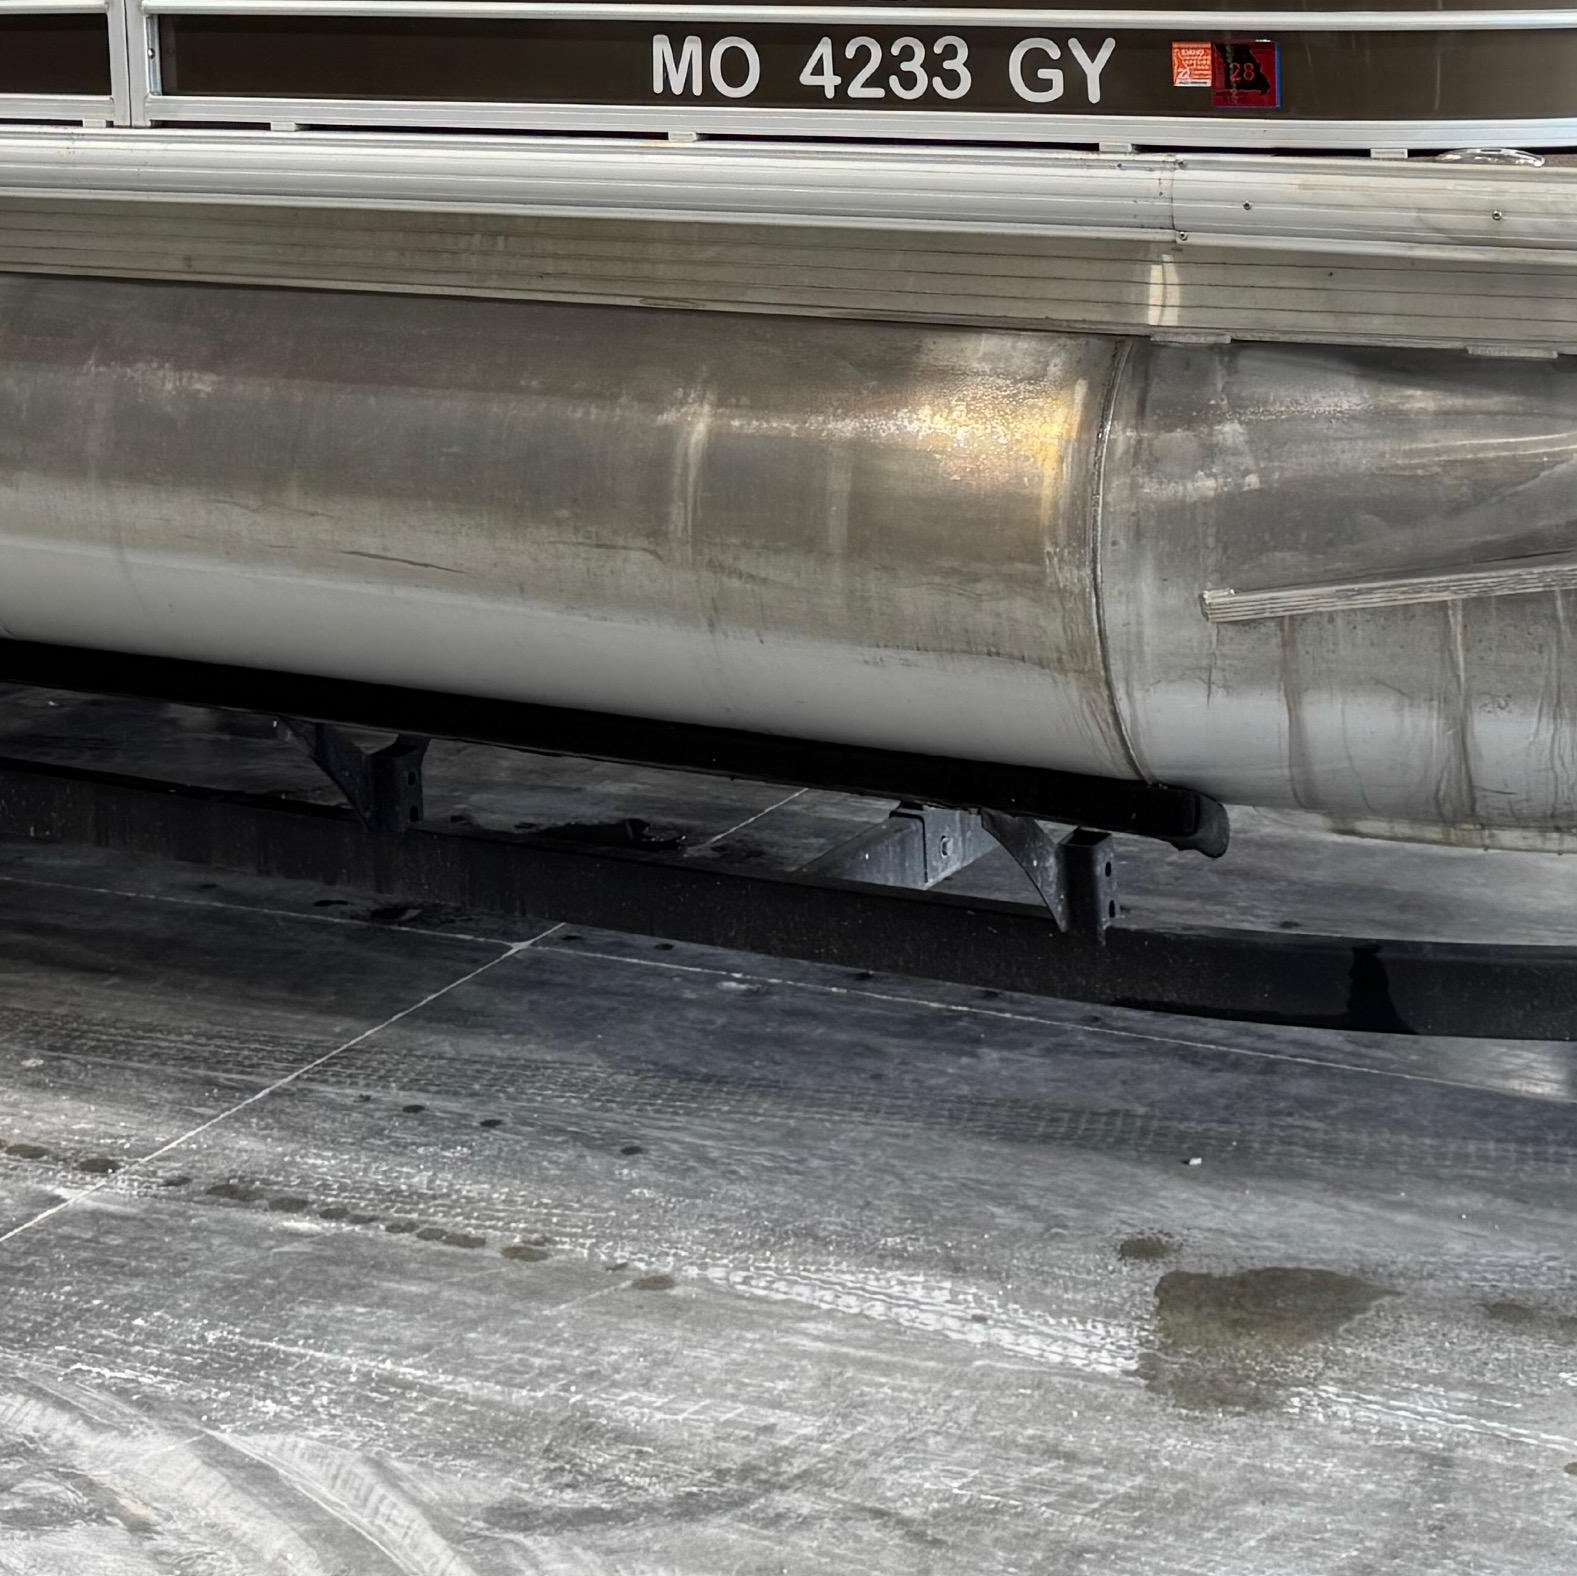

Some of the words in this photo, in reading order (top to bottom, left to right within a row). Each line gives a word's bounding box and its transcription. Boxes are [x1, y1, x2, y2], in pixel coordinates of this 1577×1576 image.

[651, 34, 761, 99] MO
[799, 35, 973, 100] 4233
[1008, 36, 1117, 104] GY
[1230, 62, 1255, 81] 28
